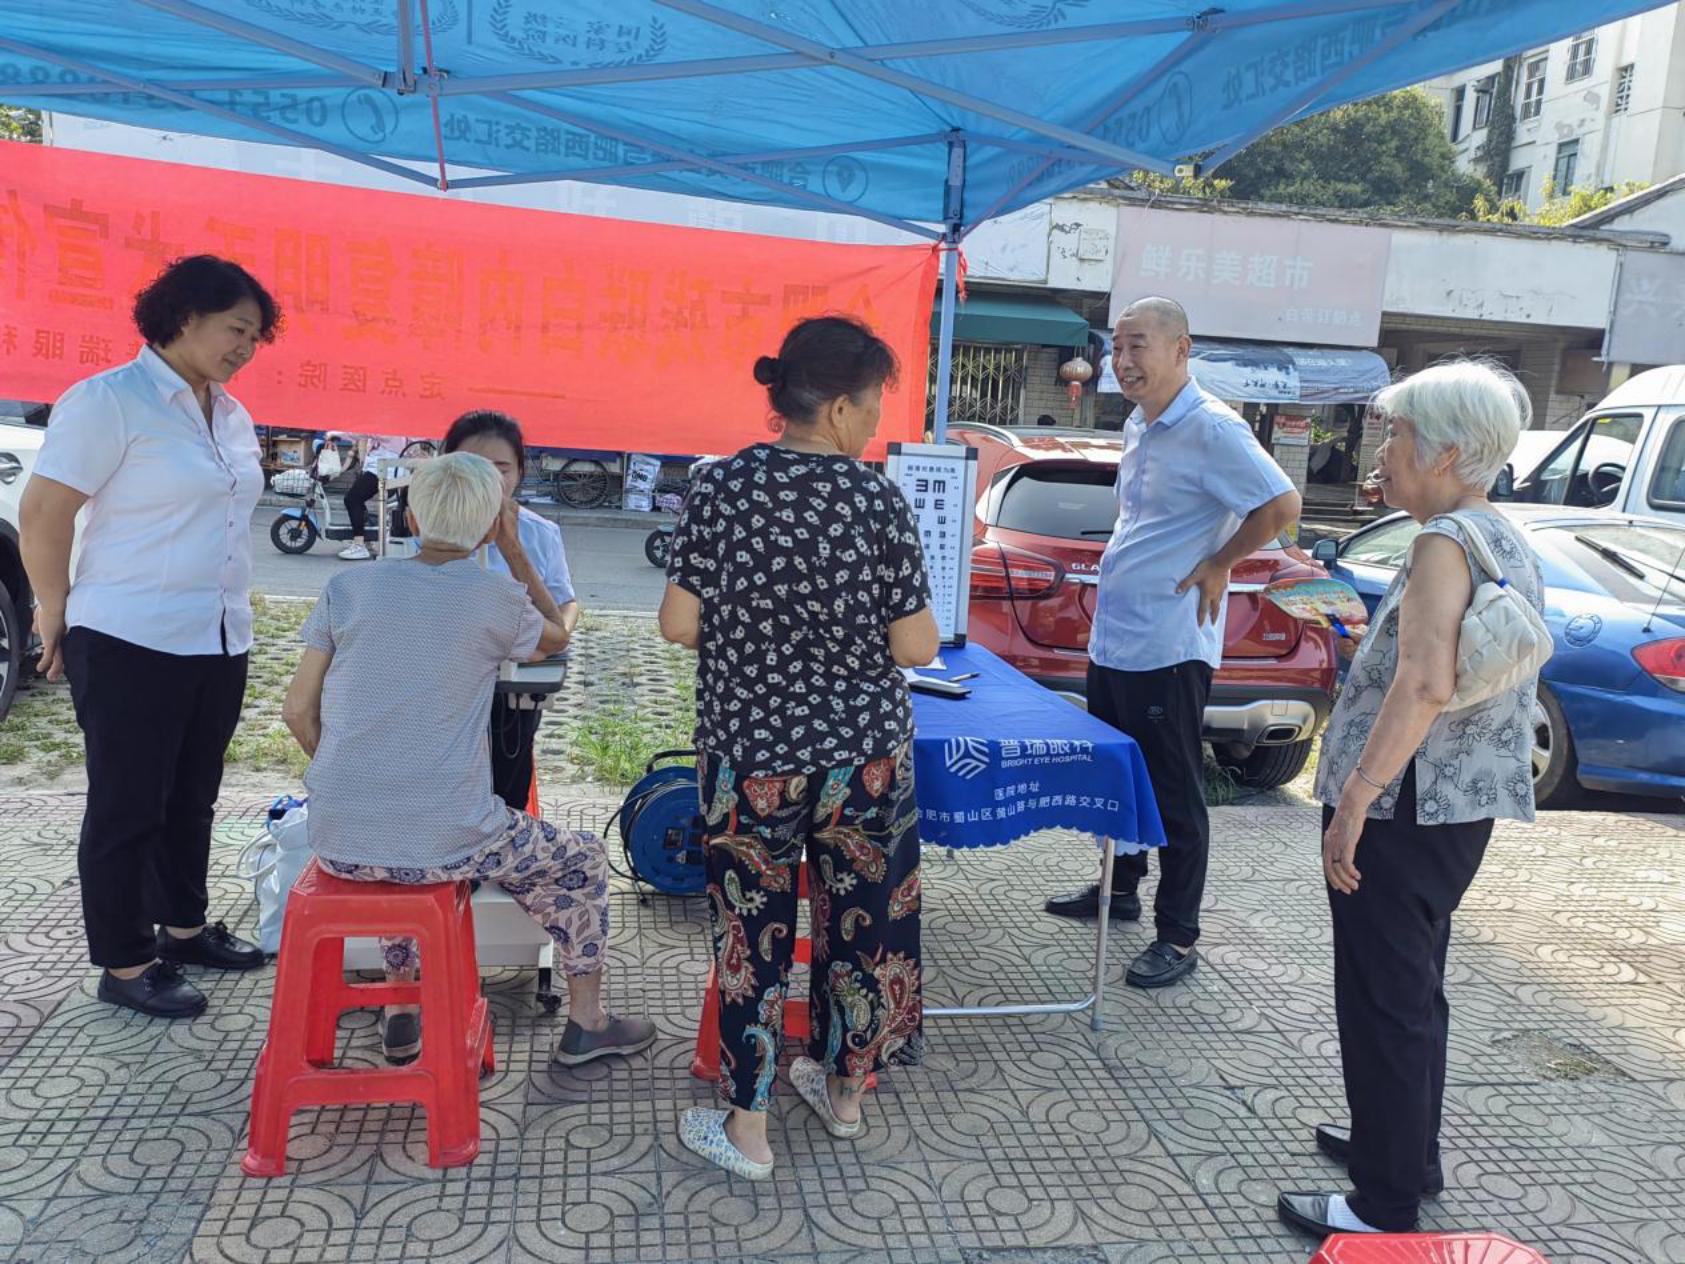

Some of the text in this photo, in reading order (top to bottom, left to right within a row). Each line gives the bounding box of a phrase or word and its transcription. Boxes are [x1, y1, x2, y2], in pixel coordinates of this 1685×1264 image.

[1139, 242, 1314, 290] 鲜乐美超市
[1071, 562, 1100, 571] GLA
[1001, 754, 1093, 768] BRIGHT EYE HOSPITAL
[994, 781, 1040, 800] 医院地址
